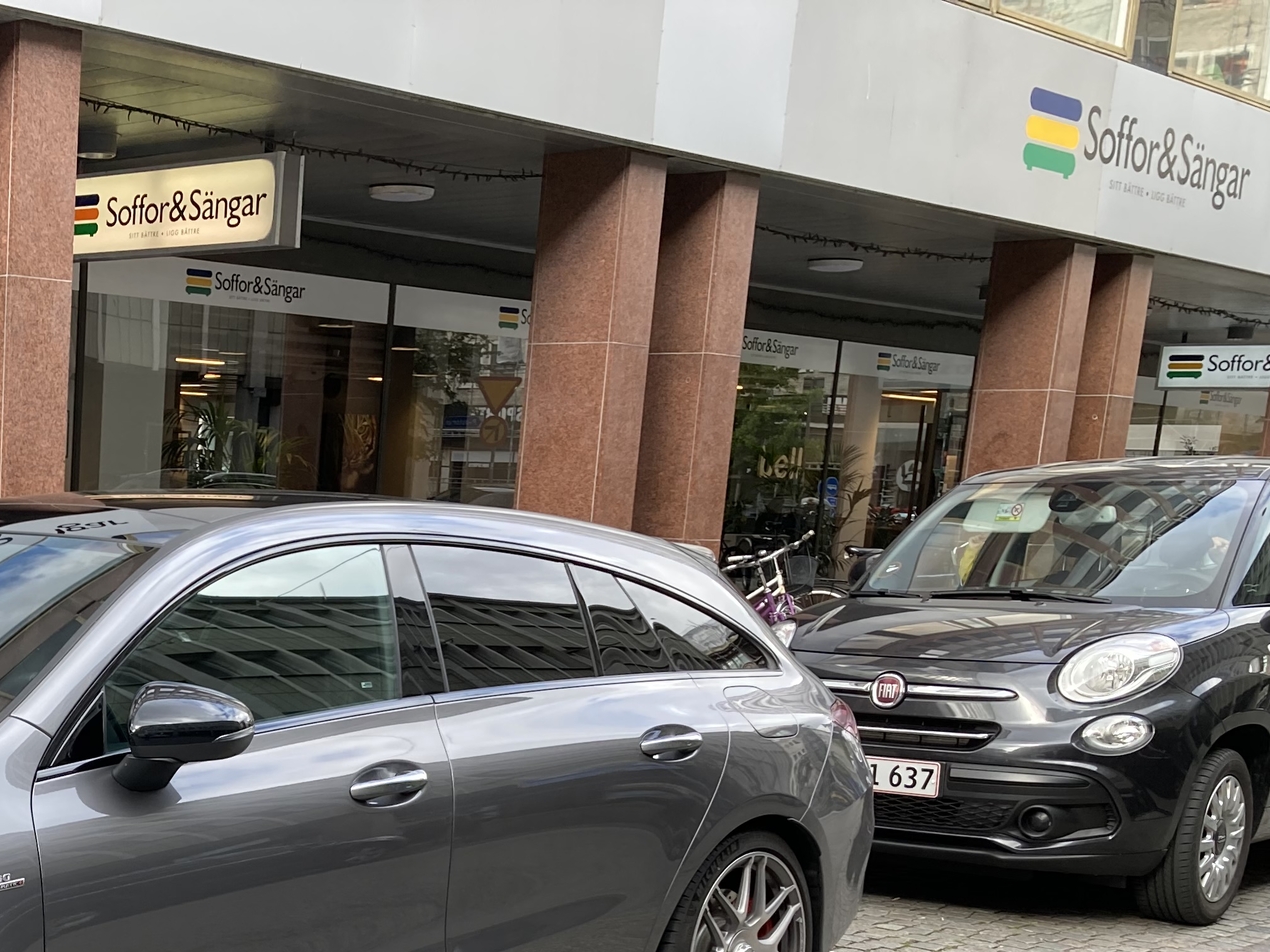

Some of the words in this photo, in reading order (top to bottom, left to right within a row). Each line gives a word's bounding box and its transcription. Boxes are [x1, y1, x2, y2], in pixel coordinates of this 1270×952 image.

[1083, 105, 1251, 211] Soffor&Sängar
[1109, 179, 1123, 192] SITT
[1151, 189, 1165, 204] LIGG
[106, 188, 267, 228] Soffor&Sängar
[128, 231, 139, 239] SITT
[166, 228, 179, 237] LIGG
[215, 271, 306, 303] Soffor&Sängar
[742, 335, 799, 359] Soffor&Sängar
[892, 354, 941, 375] Soffor&Sängar
[878, 683, 898, 699] FIAT
[889, 764, 935, 790] 637
